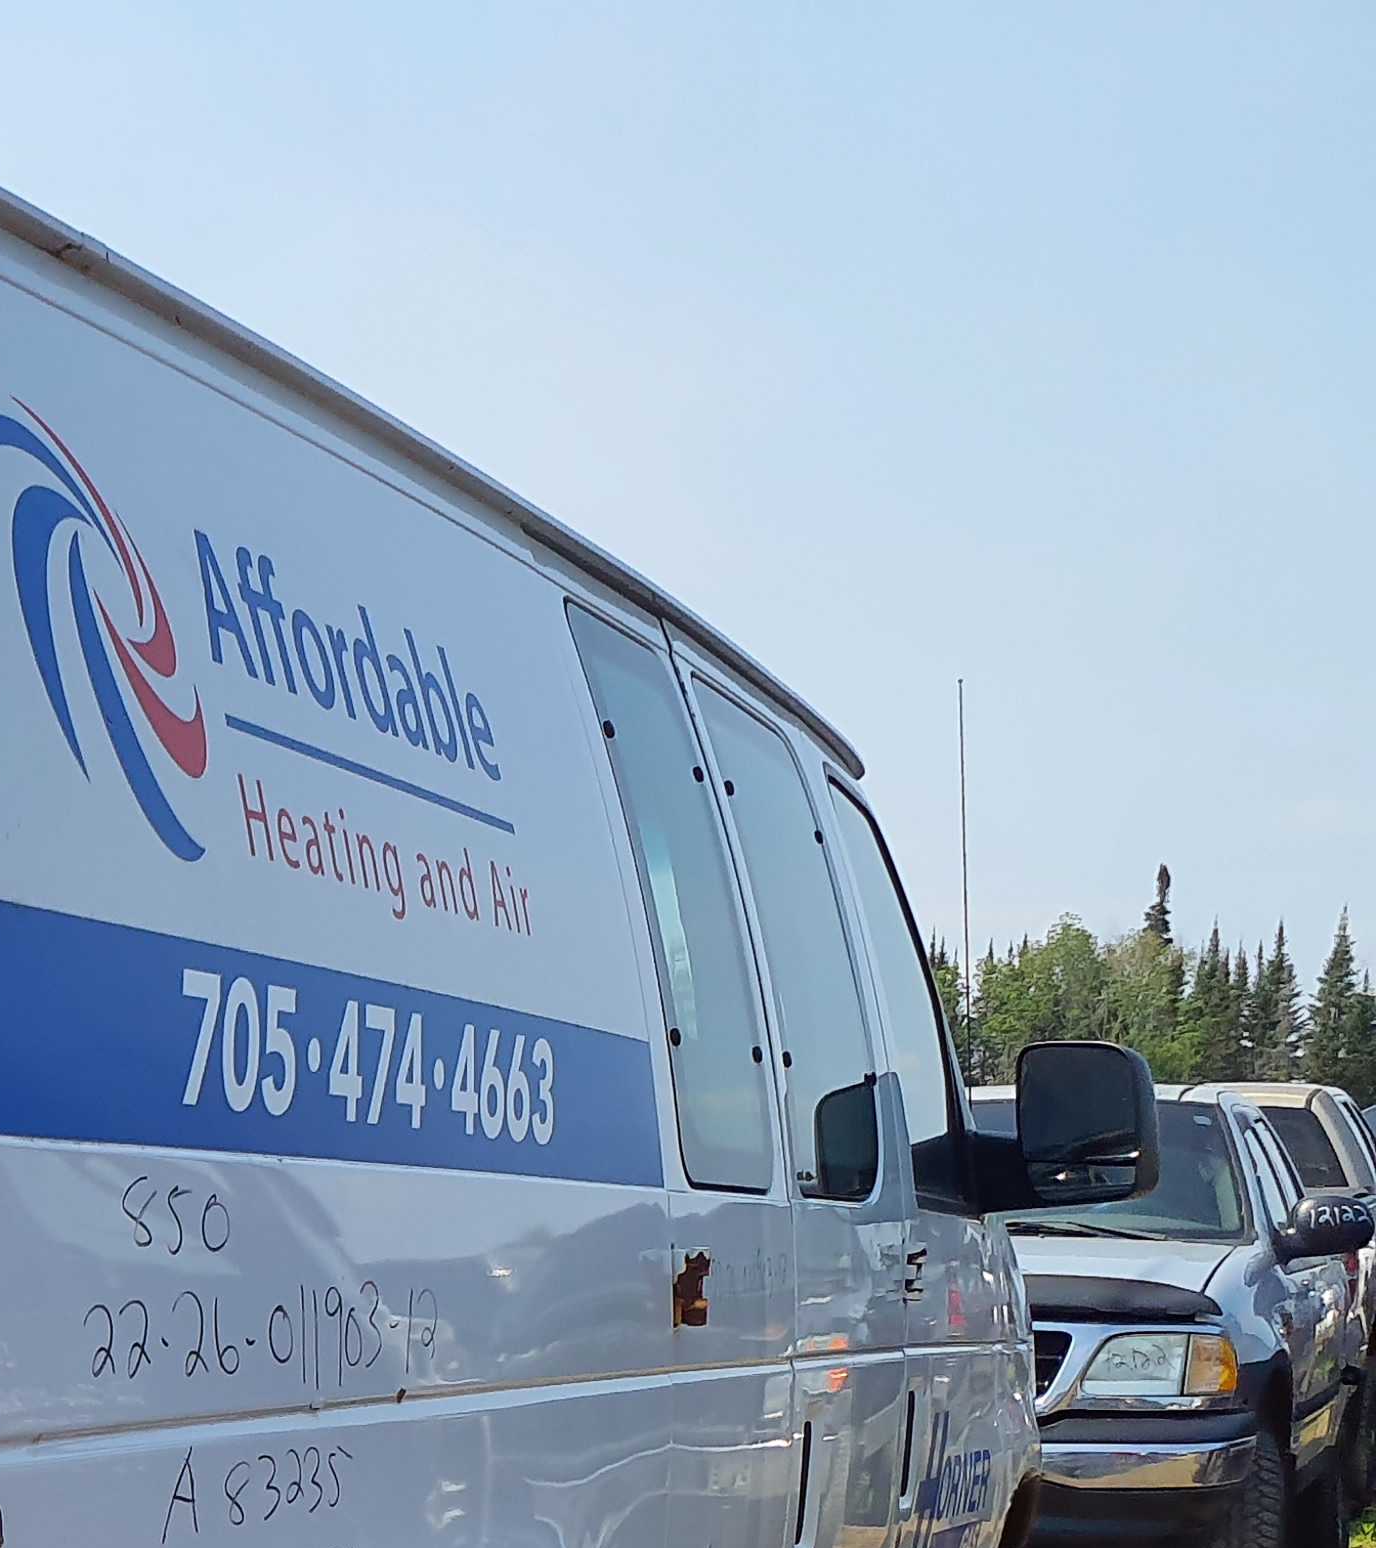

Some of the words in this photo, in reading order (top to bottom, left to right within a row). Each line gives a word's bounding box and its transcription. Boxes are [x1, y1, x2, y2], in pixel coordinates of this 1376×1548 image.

[193, 527, 502, 782] Affordable
[235, 772, 408, 921] Heating
[416, 847, 481, 923] and
[489, 859, 533, 938] Air
[122, 1176, 231, 1255] 850
[161, 1445, 200, 1544] A
[223, 1445, 354, 1526] 83235
